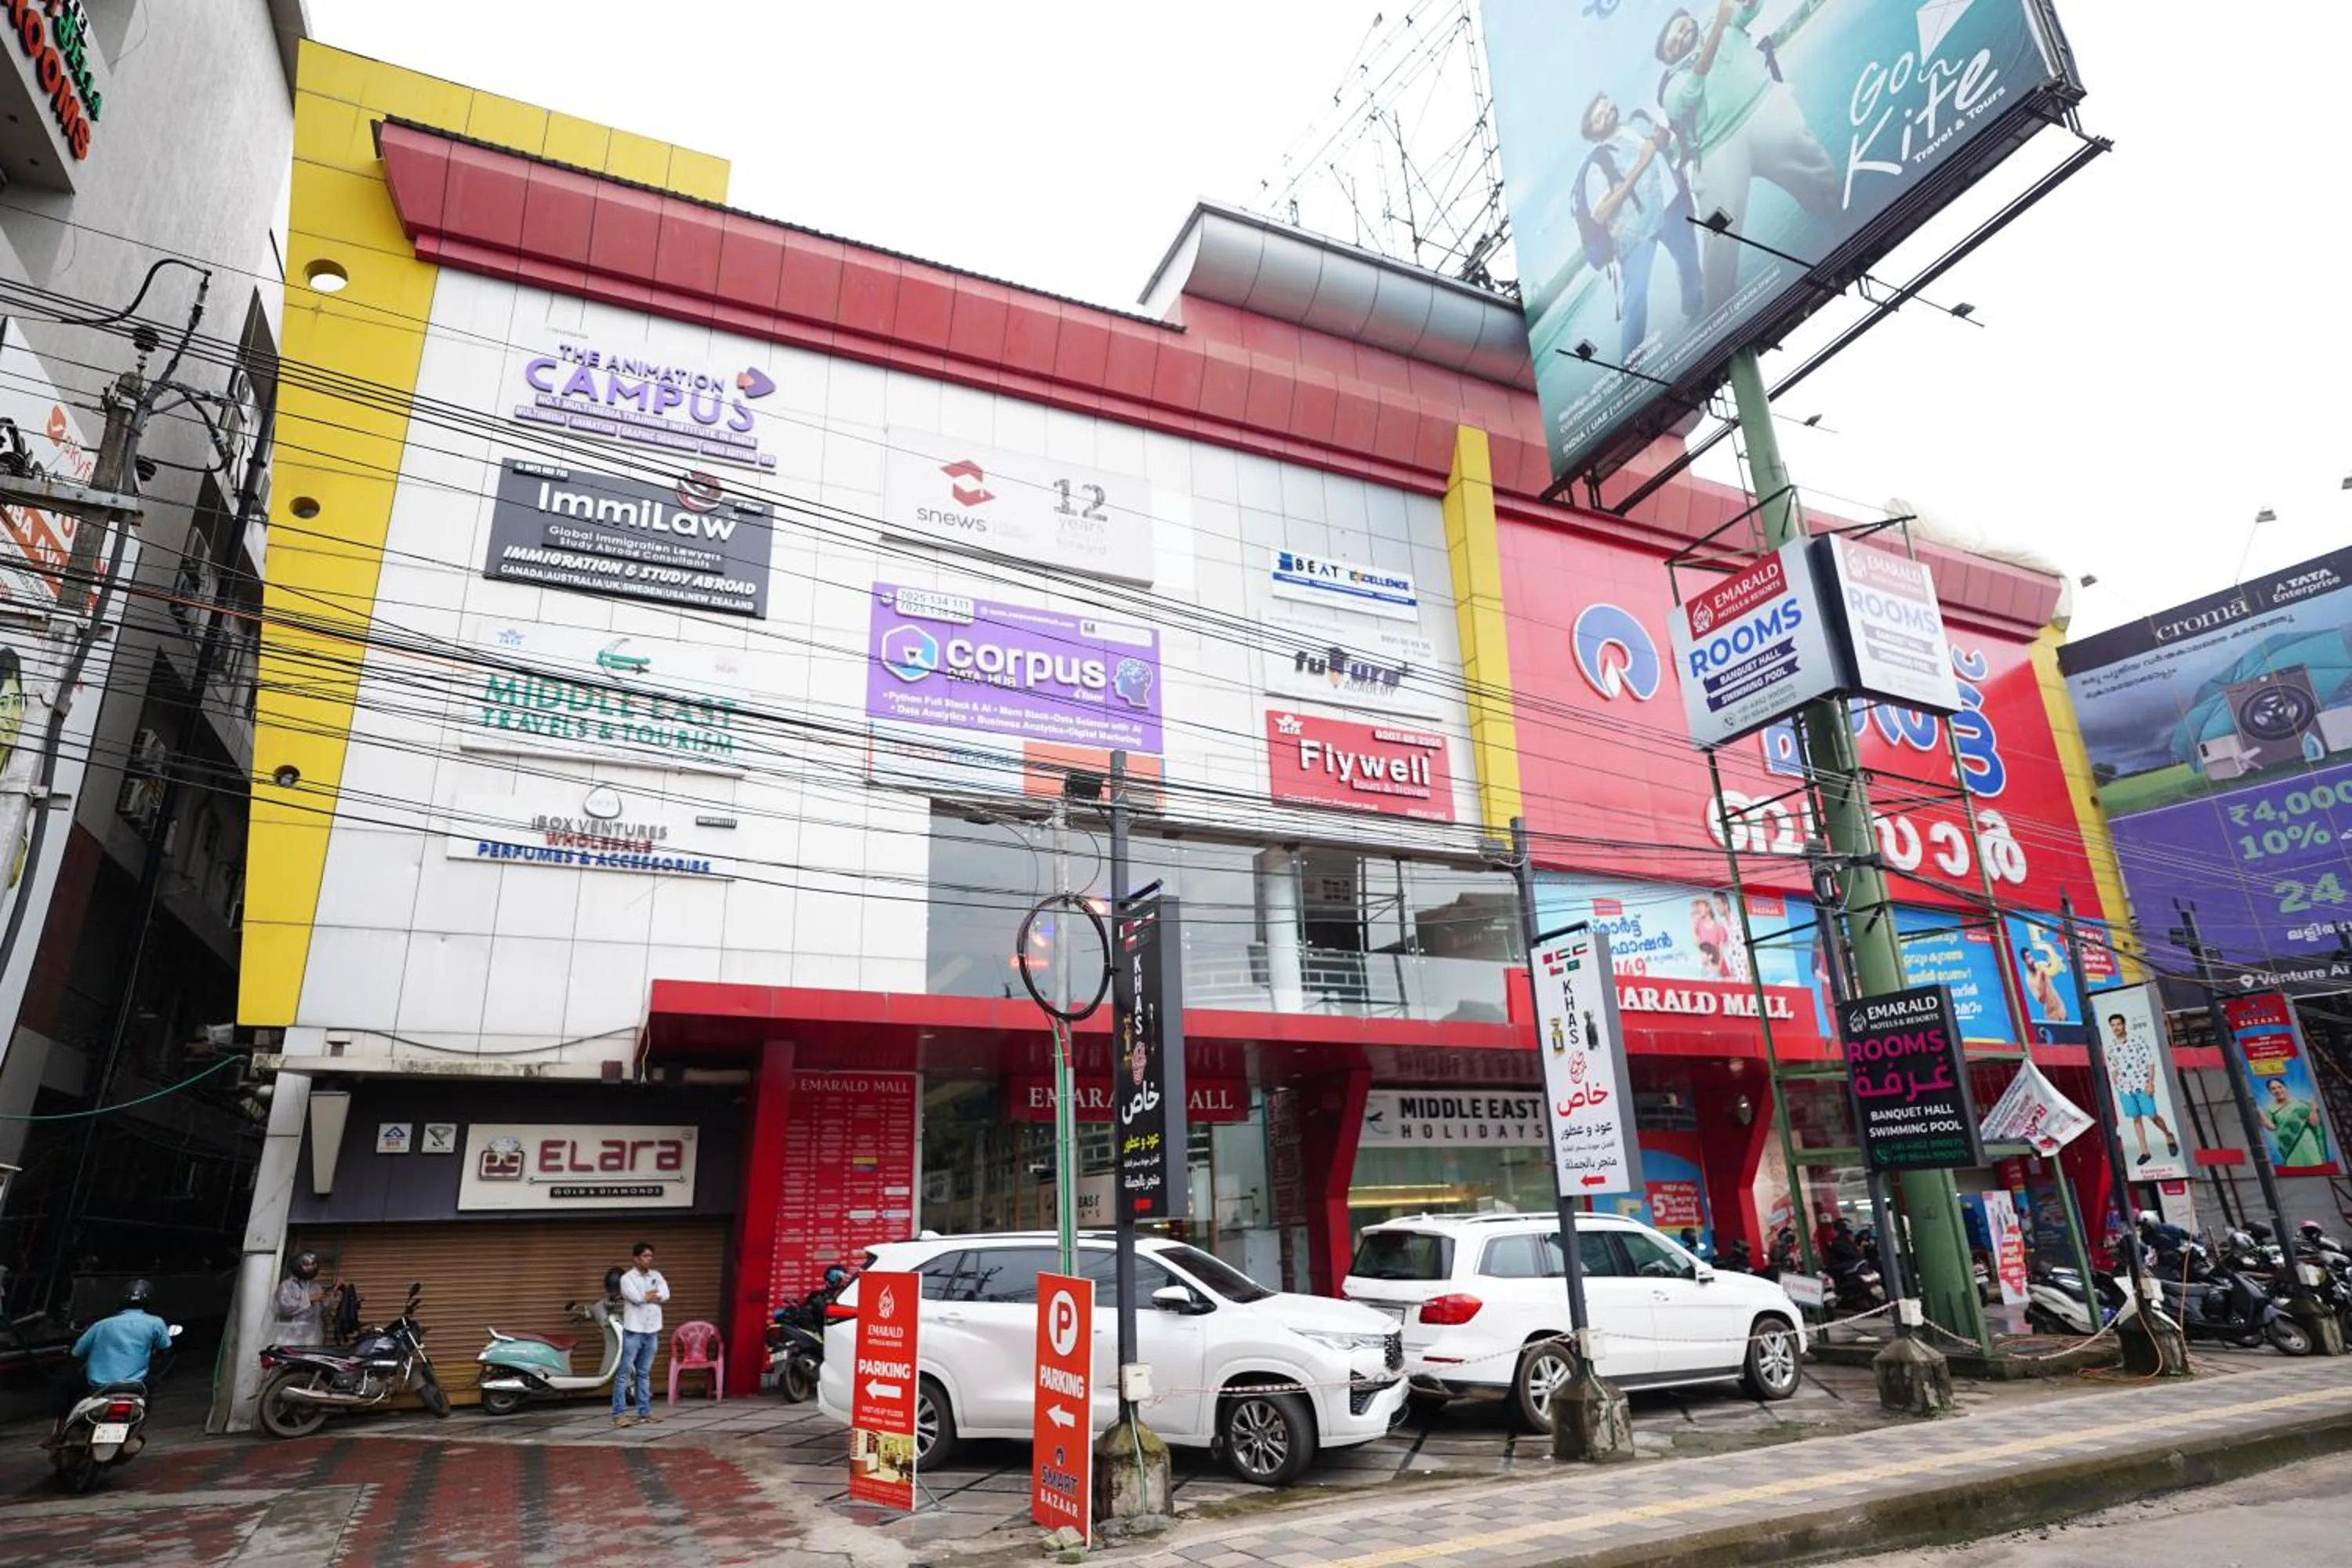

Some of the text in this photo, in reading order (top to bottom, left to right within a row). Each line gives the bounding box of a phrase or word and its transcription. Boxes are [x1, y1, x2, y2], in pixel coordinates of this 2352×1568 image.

[1913, 127, 1953, 164] Travel
[1966, 85, 2006, 118] Tours
[560, 345, 725, 394] THE ANIMATION
[525, 358, 755, 432] CAMPUS
[539, 482, 737, 543] ImmiLaw
[1053, 478, 1109, 523] 12
[916, 506, 988, 534] snews
[550, 525, 721, 563] Global Immigration Lawyers
[559, 536, 710, 570] Study Abroad Consultants
[503, 546, 757, 597] IMMIGRATION & STUDY ABROAD
[1714, 564, 1779, 608] EMARALD
[2276, 583, 2286, 594] A
[2287, 568, 2332, 587] TATA
[711, 596, 755, 611] ZEALAND
[2271, 575, 2341, 604] Enterprise
[1847, 587, 1939, 635] ROOMS
[1689, 597, 1802, 678] ROOMS
[946, 639, 1107, 690] corpus
[947, 667, 1018, 689] DATA HUB
[1719, 648, 1782, 686] BANQUET HALL
[1343, 679, 1396, 697] ACADEMY
[1721, 677, 1763, 705] SWIMMING
[1765, 666, 1788, 685] POOL
[481, 706, 734, 754] TRAVELS & TOURISM
[1299, 739, 1431, 786] Flywell
[545, 831, 654, 854] WHOLESALE
[579, 818, 668, 840] VENTURES
[2238, 822, 2331, 860] 10%
[477, 842, 711, 874] PERFUMES & ACCESSORIES
[2273, 872, 2347, 914] 24
[1134, 953, 1144, 1036] KHAS
[2258, 968, 2327, 987] Venture
[1563, 979, 1580, 1045] KHAS
[1616, 986, 1795, 1020] ARALD MALL
[1867, 996, 1938, 1020] EMARALD
[1906, 1012, 1940, 1026] RESORTS
[1847, 1029, 1946, 1065] ROOMS
[800, 1078, 910, 1094] EMARALD MALL
[1122, 1080, 1160, 1125] خاص
[1189, 1089, 1234, 1110] ALL
[1557, 1082, 1610, 1117] خاص
[1399, 1098, 1541, 1120] MIDDLE EAST
[1871, 1103, 1955, 1121] BANQUET HALL
[1401, 1123, 1544, 1139] HOLIDAYS
[1560, 1121, 1613, 1141] عود و عطور
[1869, 1120, 1963, 1138] SWIMMING POOL
[1596, 1156, 1617, 1173] متجر
[554, 1187, 662, 1196] GOLD & DIAMONDS
[868, 1323, 903, 1338] EMARALD
[1056, 1301, 1073, 1345] P
[858, 1359, 911, 1380] PARKING
[1040, 1364, 1084, 1399] PARKING
[1041, 1465, 1078, 1497] SMART
[1040, 1487, 1078, 1519] BAZAAR
